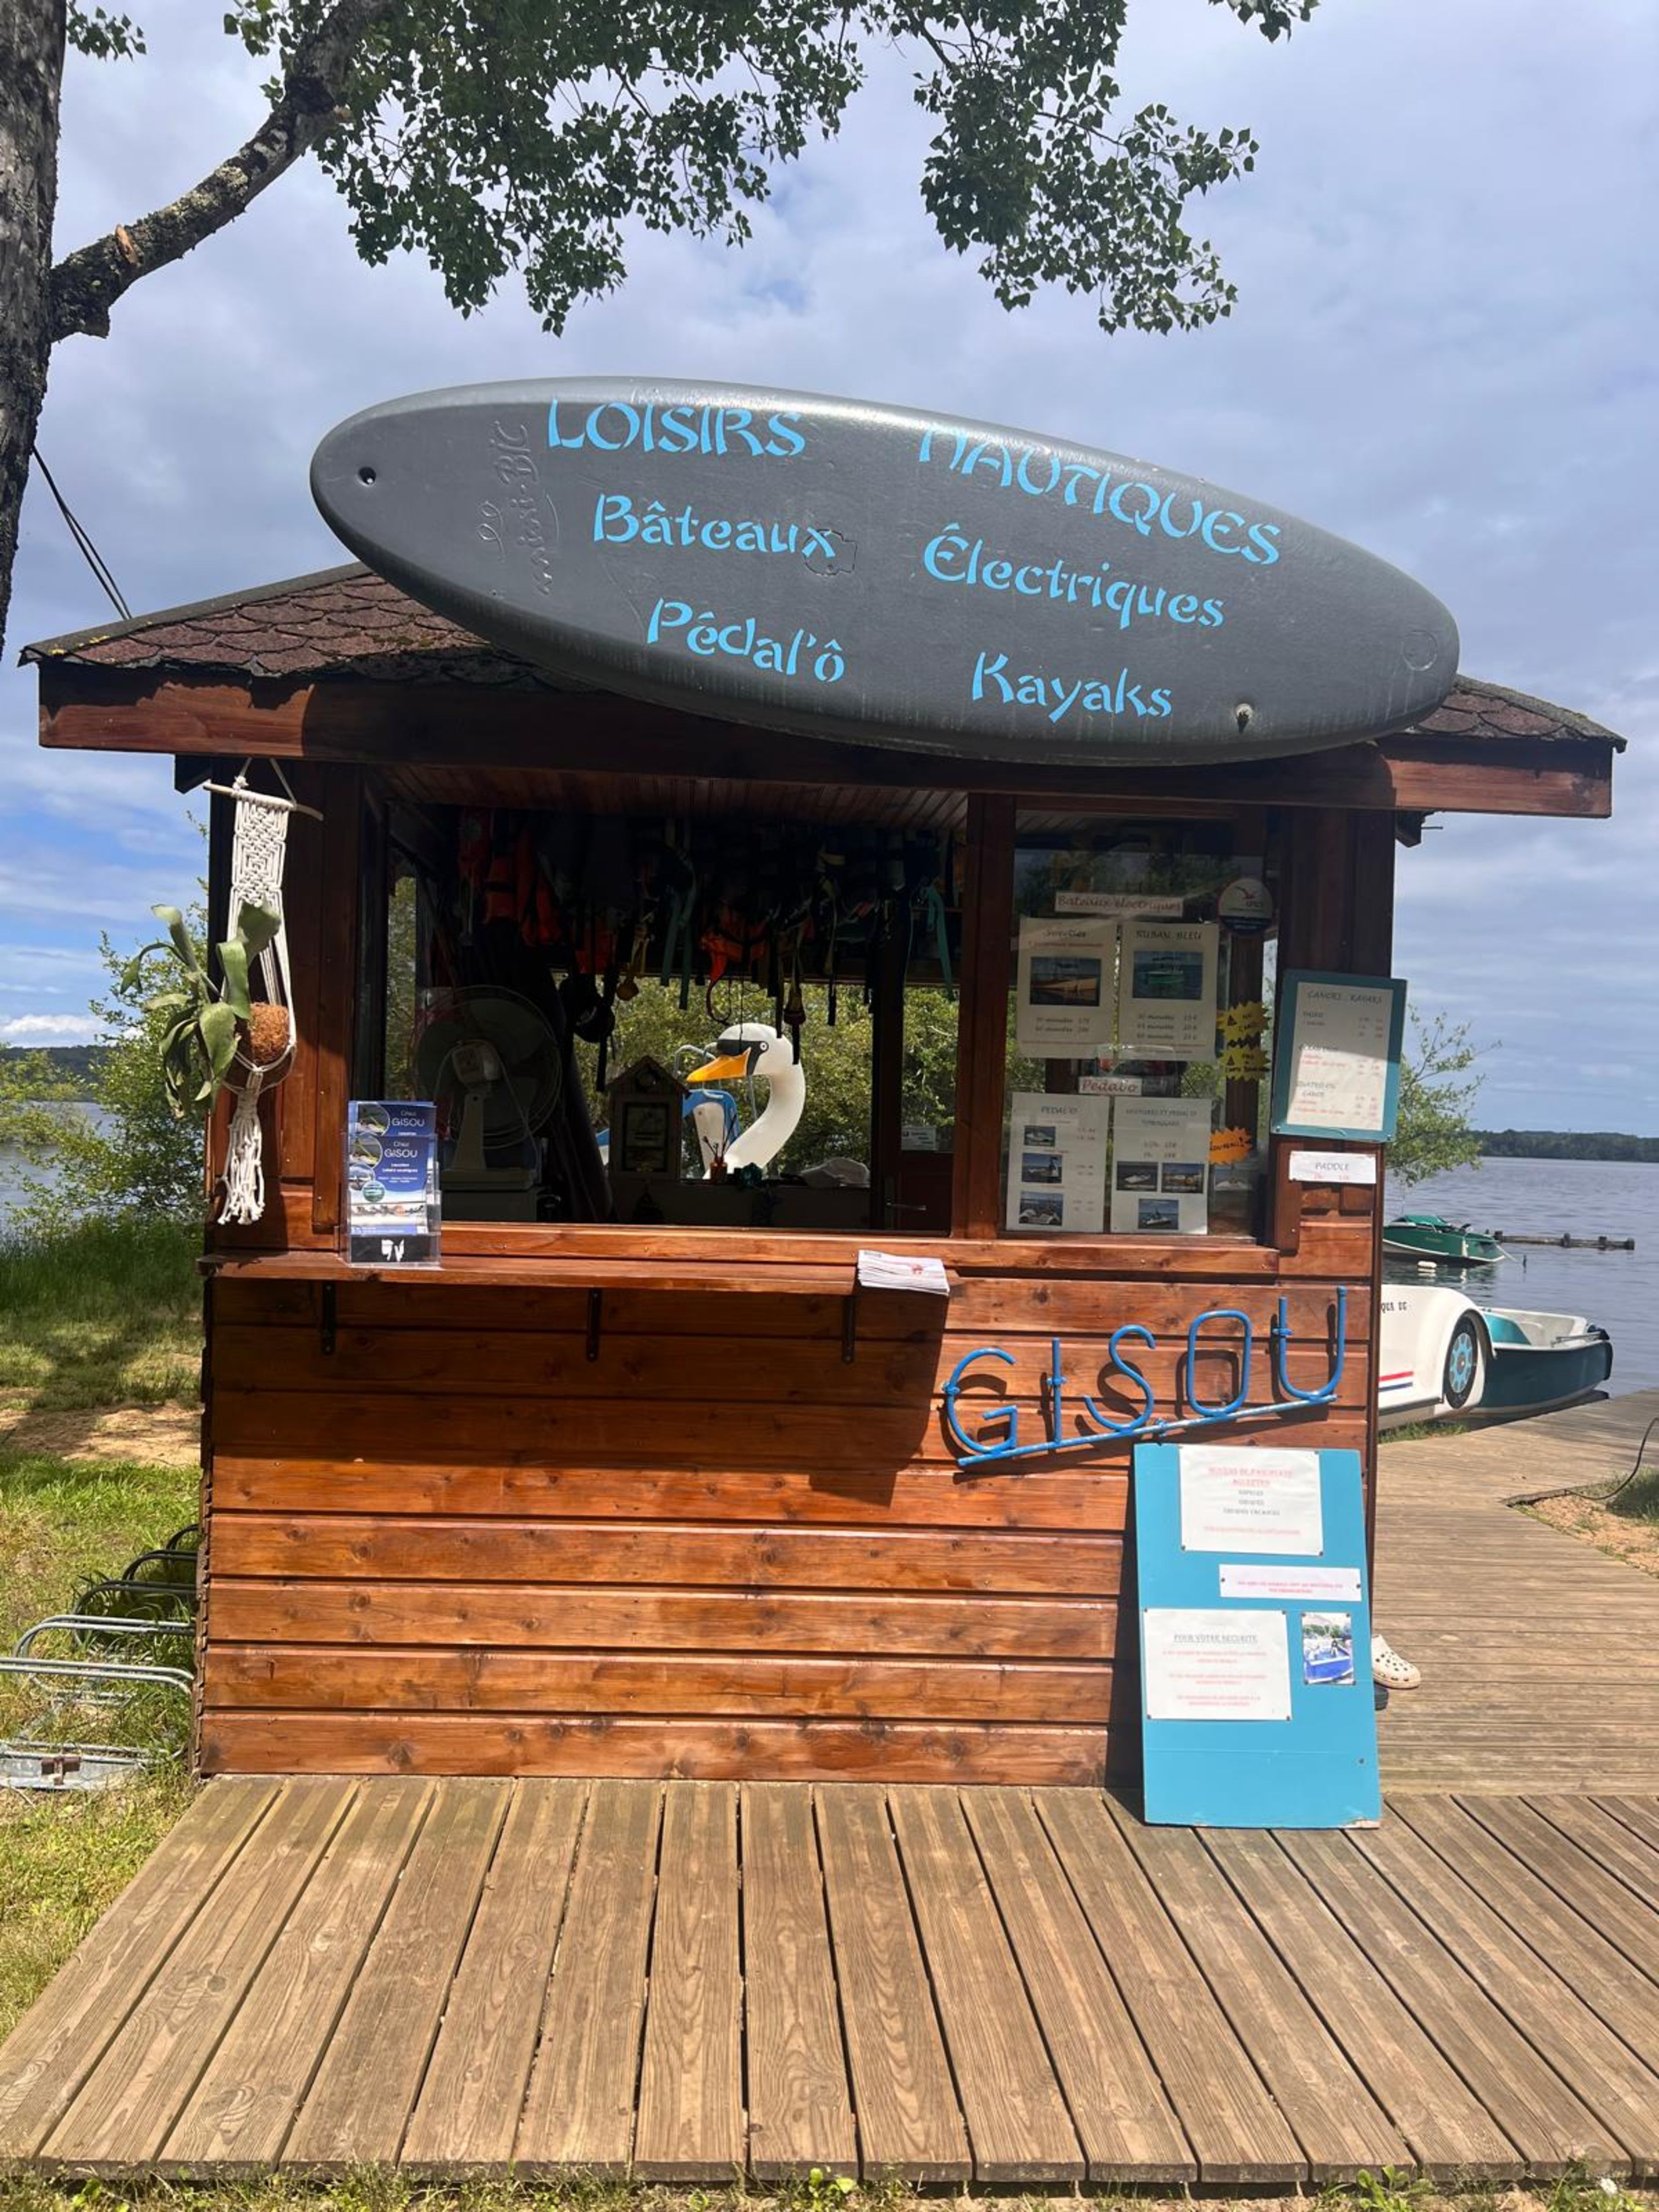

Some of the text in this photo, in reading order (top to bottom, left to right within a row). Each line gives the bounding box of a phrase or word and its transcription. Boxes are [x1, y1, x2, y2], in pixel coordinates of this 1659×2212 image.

[548, 399, 1281, 565] LOISIRS NAUTIQUES
[593, 494, 1226, 630] Bâteaux Électriques
[648, 597, 1173, 724] Pédal'ô Kayaks
[383, 1148, 419, 1158] GISOU
[391, 1117, 426, 1127] GISOU
[942, 1286, 1347, 1454] GISOU
